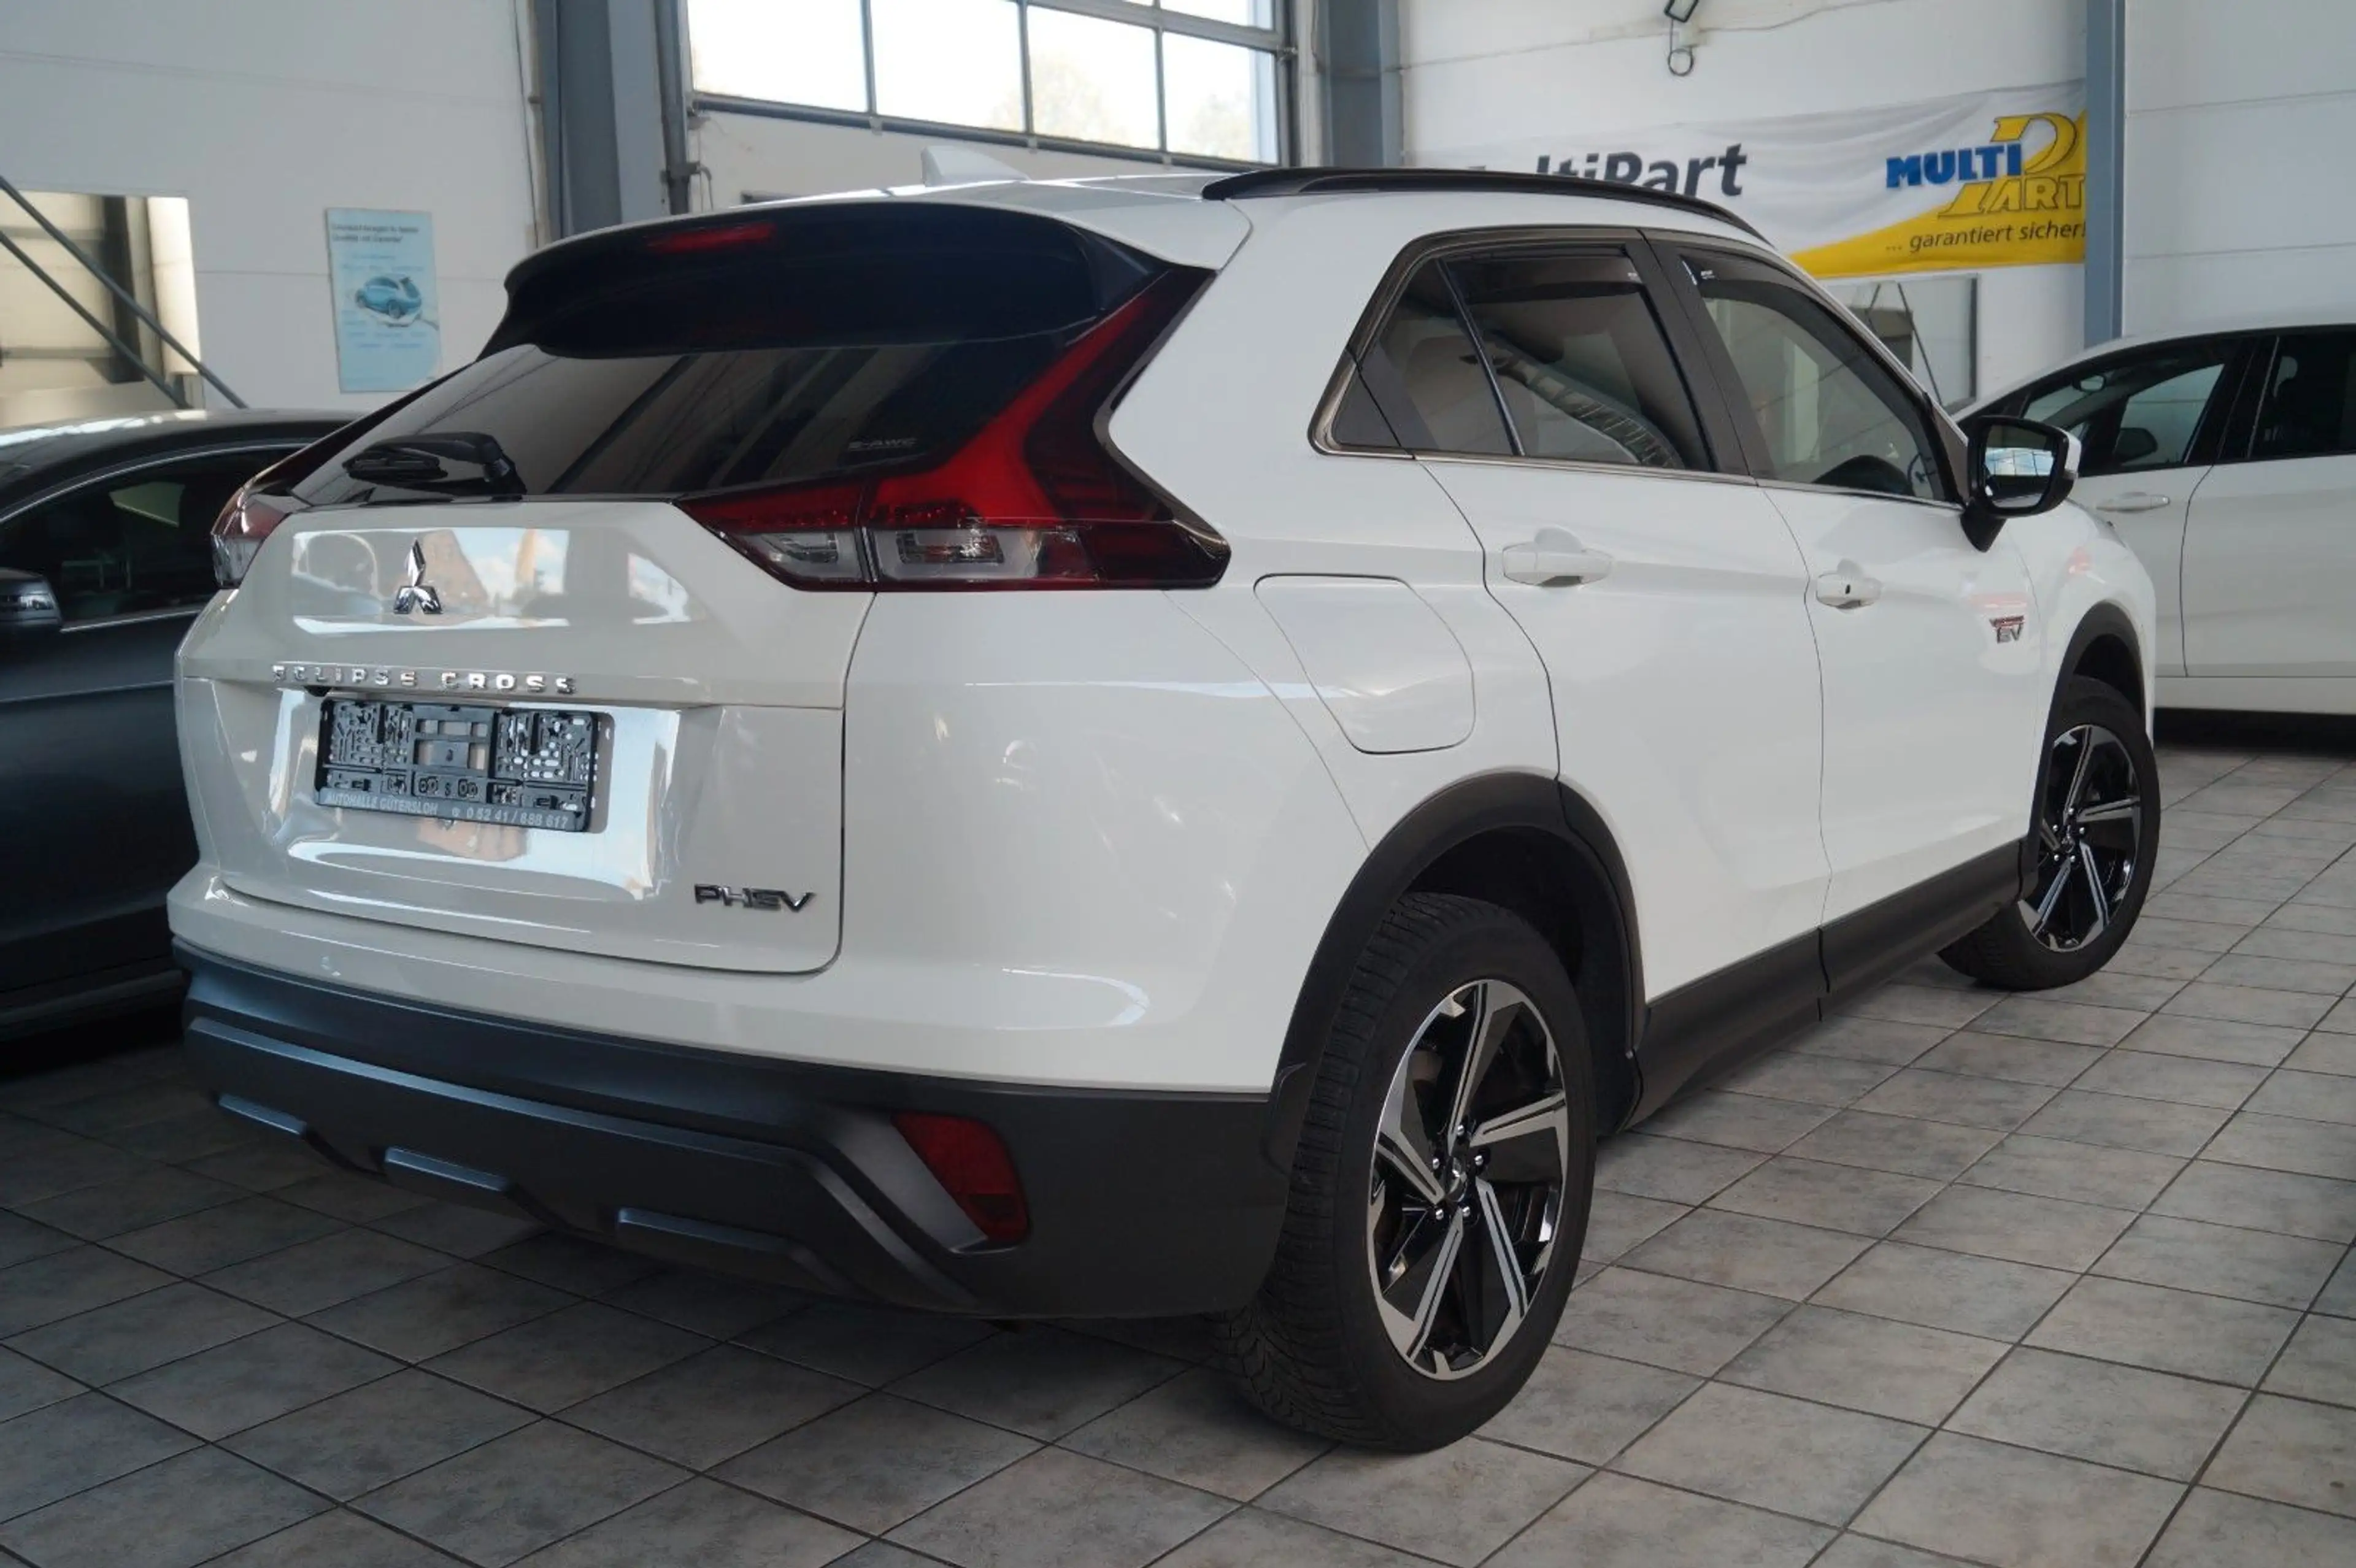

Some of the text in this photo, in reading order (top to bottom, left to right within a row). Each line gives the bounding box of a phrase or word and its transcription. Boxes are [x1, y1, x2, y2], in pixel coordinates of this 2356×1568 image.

[1885, 142, 2022, 188] MULTI
[1908, 223, 2013, 253] garantiert
[272, 664, 577, 694] ECLIPSE CROSS
[323, 791, 379, 809] AUTOHALLE
[695, 883, 817, 913] PHEV
